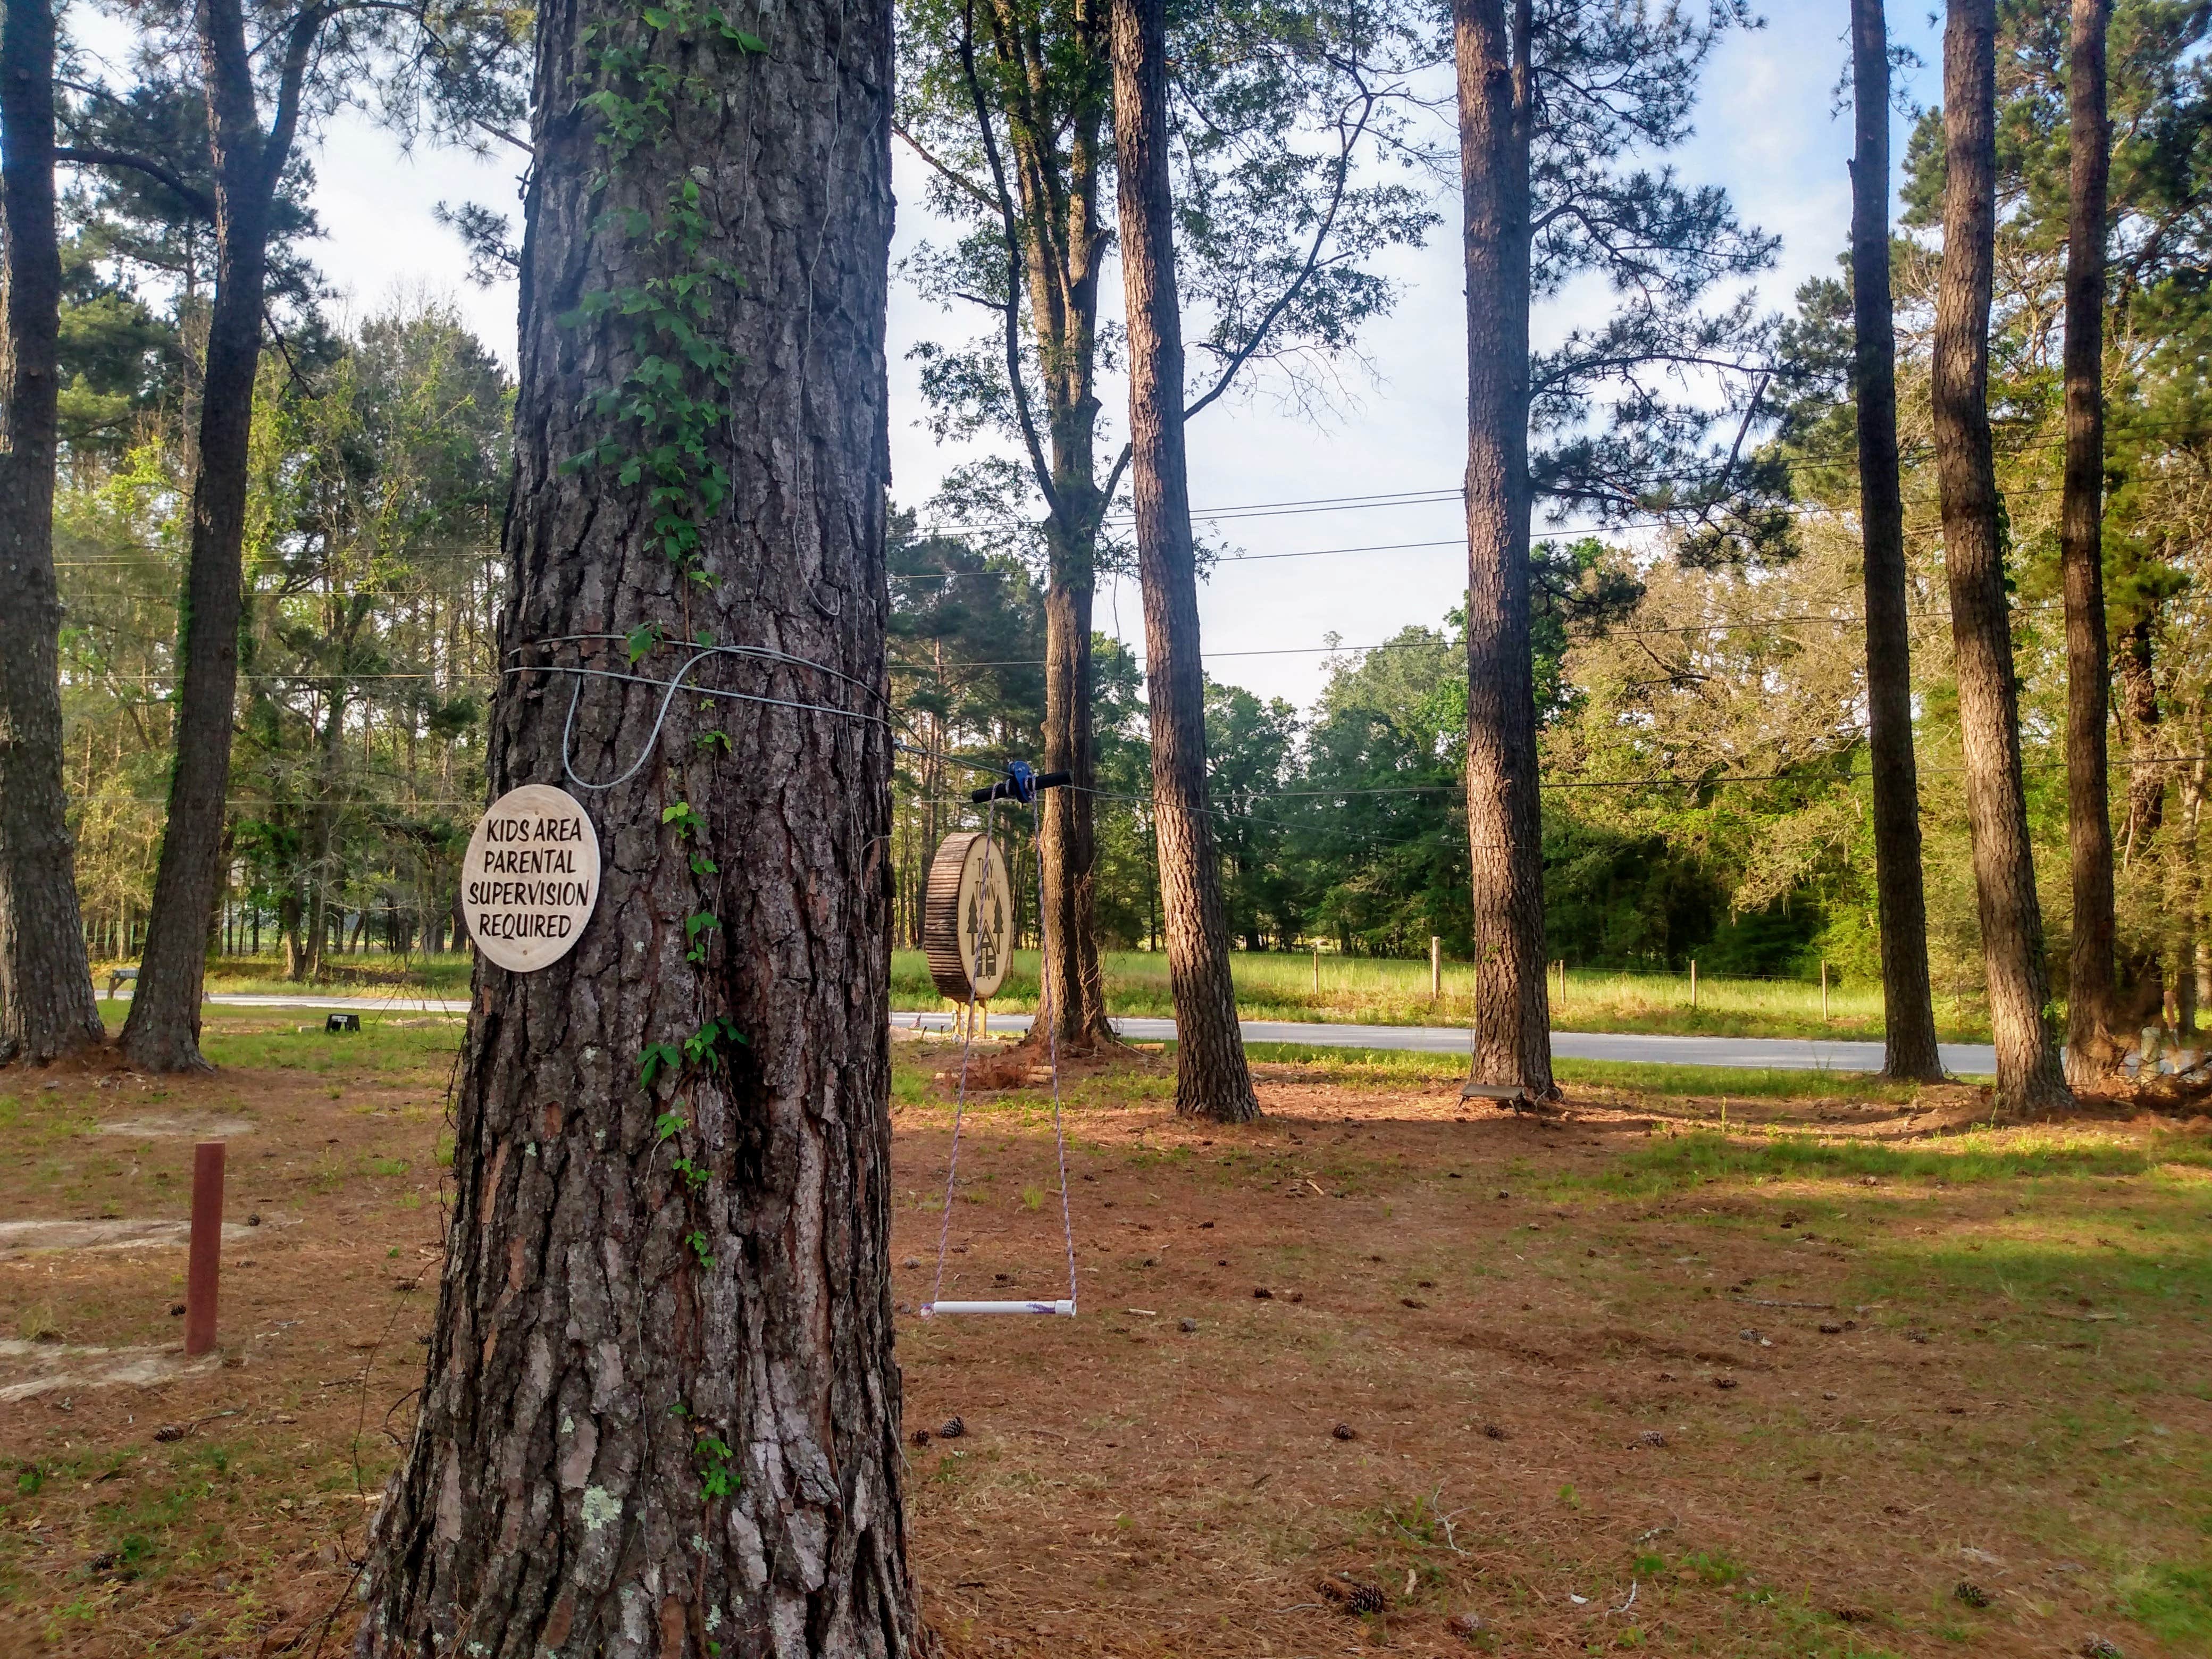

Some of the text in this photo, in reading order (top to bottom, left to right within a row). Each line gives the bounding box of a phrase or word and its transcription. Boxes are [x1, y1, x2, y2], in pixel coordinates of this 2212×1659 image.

[487, 818, 582, 842] KIDS AREA
[484, 848, 576, 873] PARENTAL
[468, 879, 590, 906] SUPERVISION
[479, 913, 572, 940] REQUIRED
